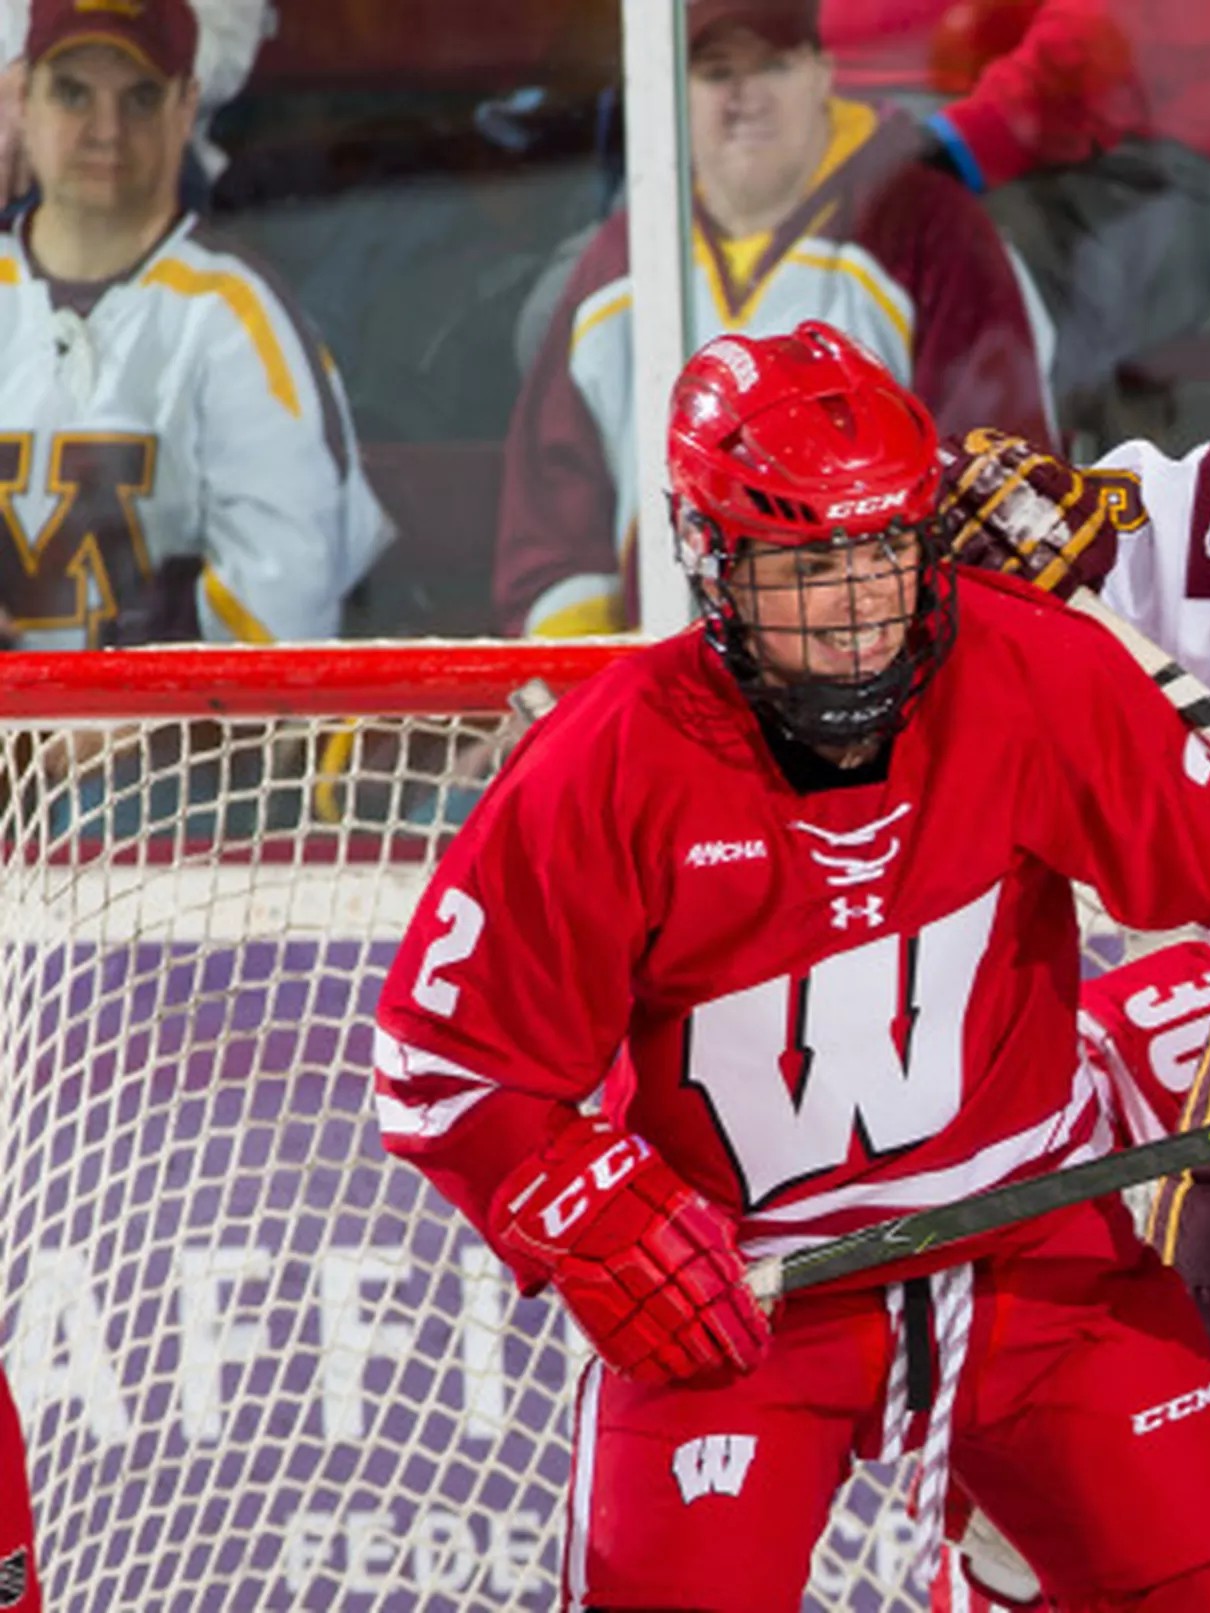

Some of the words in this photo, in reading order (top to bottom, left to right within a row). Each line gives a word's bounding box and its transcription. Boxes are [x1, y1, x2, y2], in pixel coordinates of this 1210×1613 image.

[411, 886, 486, 1019] 2
[680, 884, 1000, 1214] W
[670, 1432, 759, 1507] W
